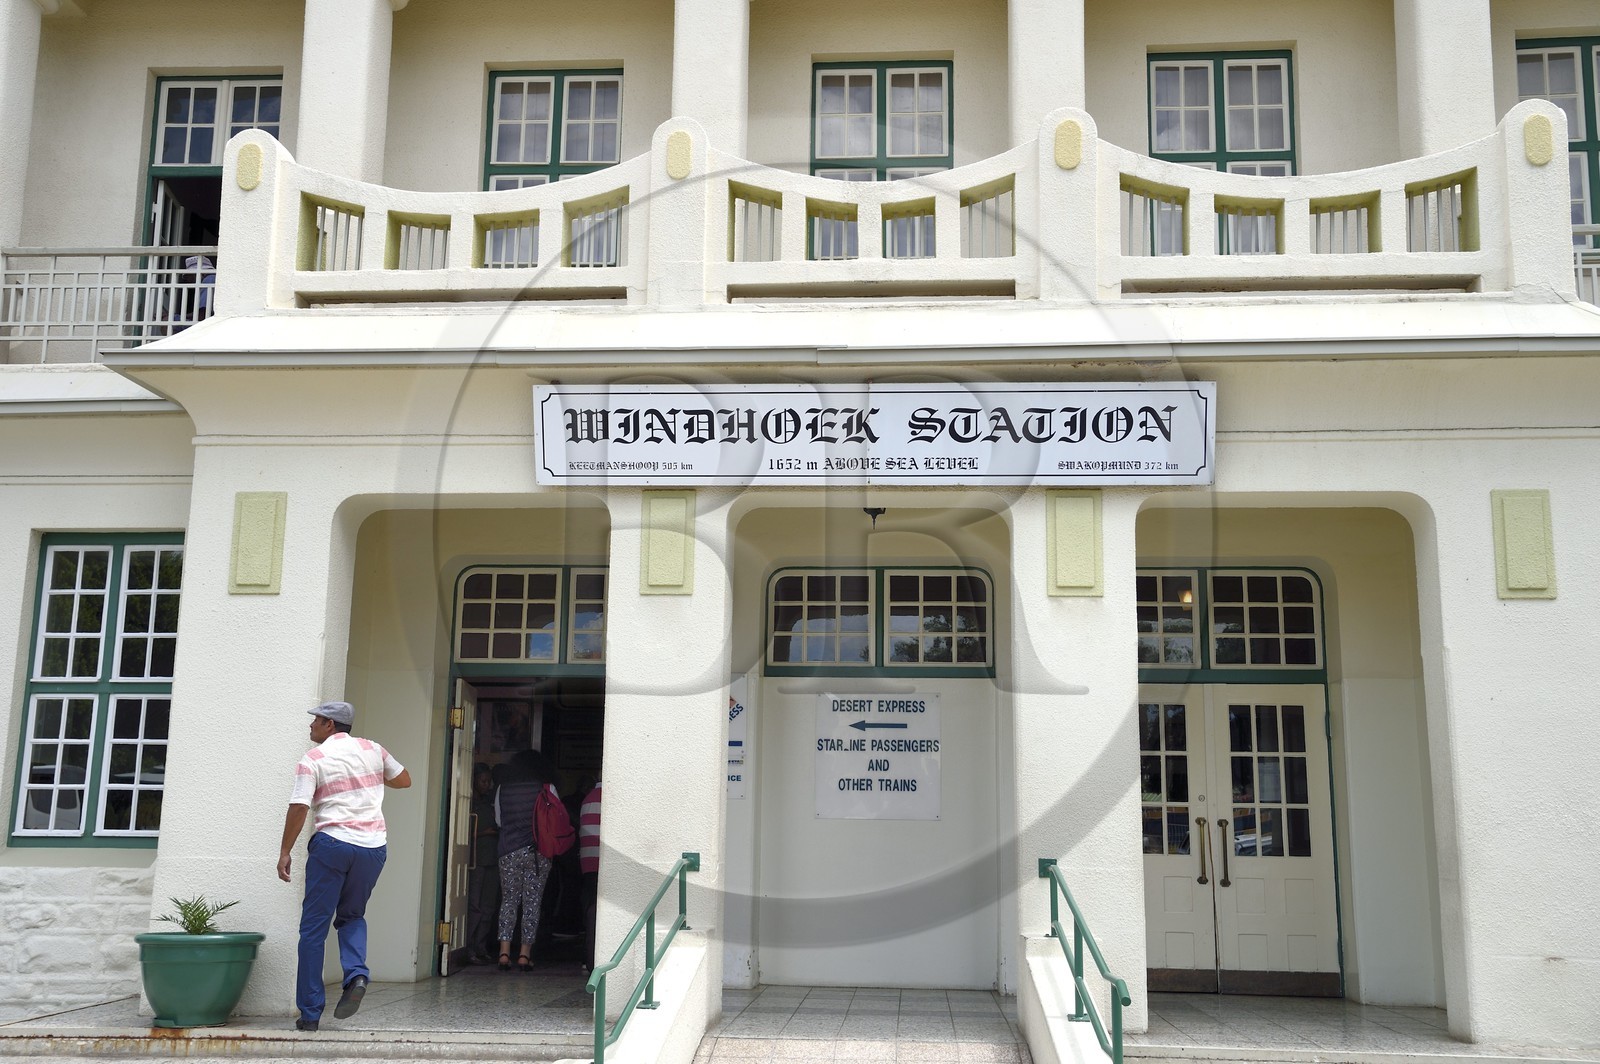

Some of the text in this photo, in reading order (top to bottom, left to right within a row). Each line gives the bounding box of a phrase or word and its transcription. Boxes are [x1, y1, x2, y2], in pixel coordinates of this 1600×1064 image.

[563, 405, 1178, 445] WINDHOEK STATION
[568, 461, 693, 472] KEETMANSHOOP 505 km
[768, 457, 979, 471] 1652 m ABOVE SEA LEVEL
[1057, 460, 1179, 472] SWAKOPMUND 372 km
[832, 699, 926, 713] DESERT EXPRESS
[870, 738, 940, 753] PASSENGERS
[867, 758, 890, 772] AND
[727, 774, 742, 782] ICE
[837, 777, 918, 792] OTHER TRAINS
